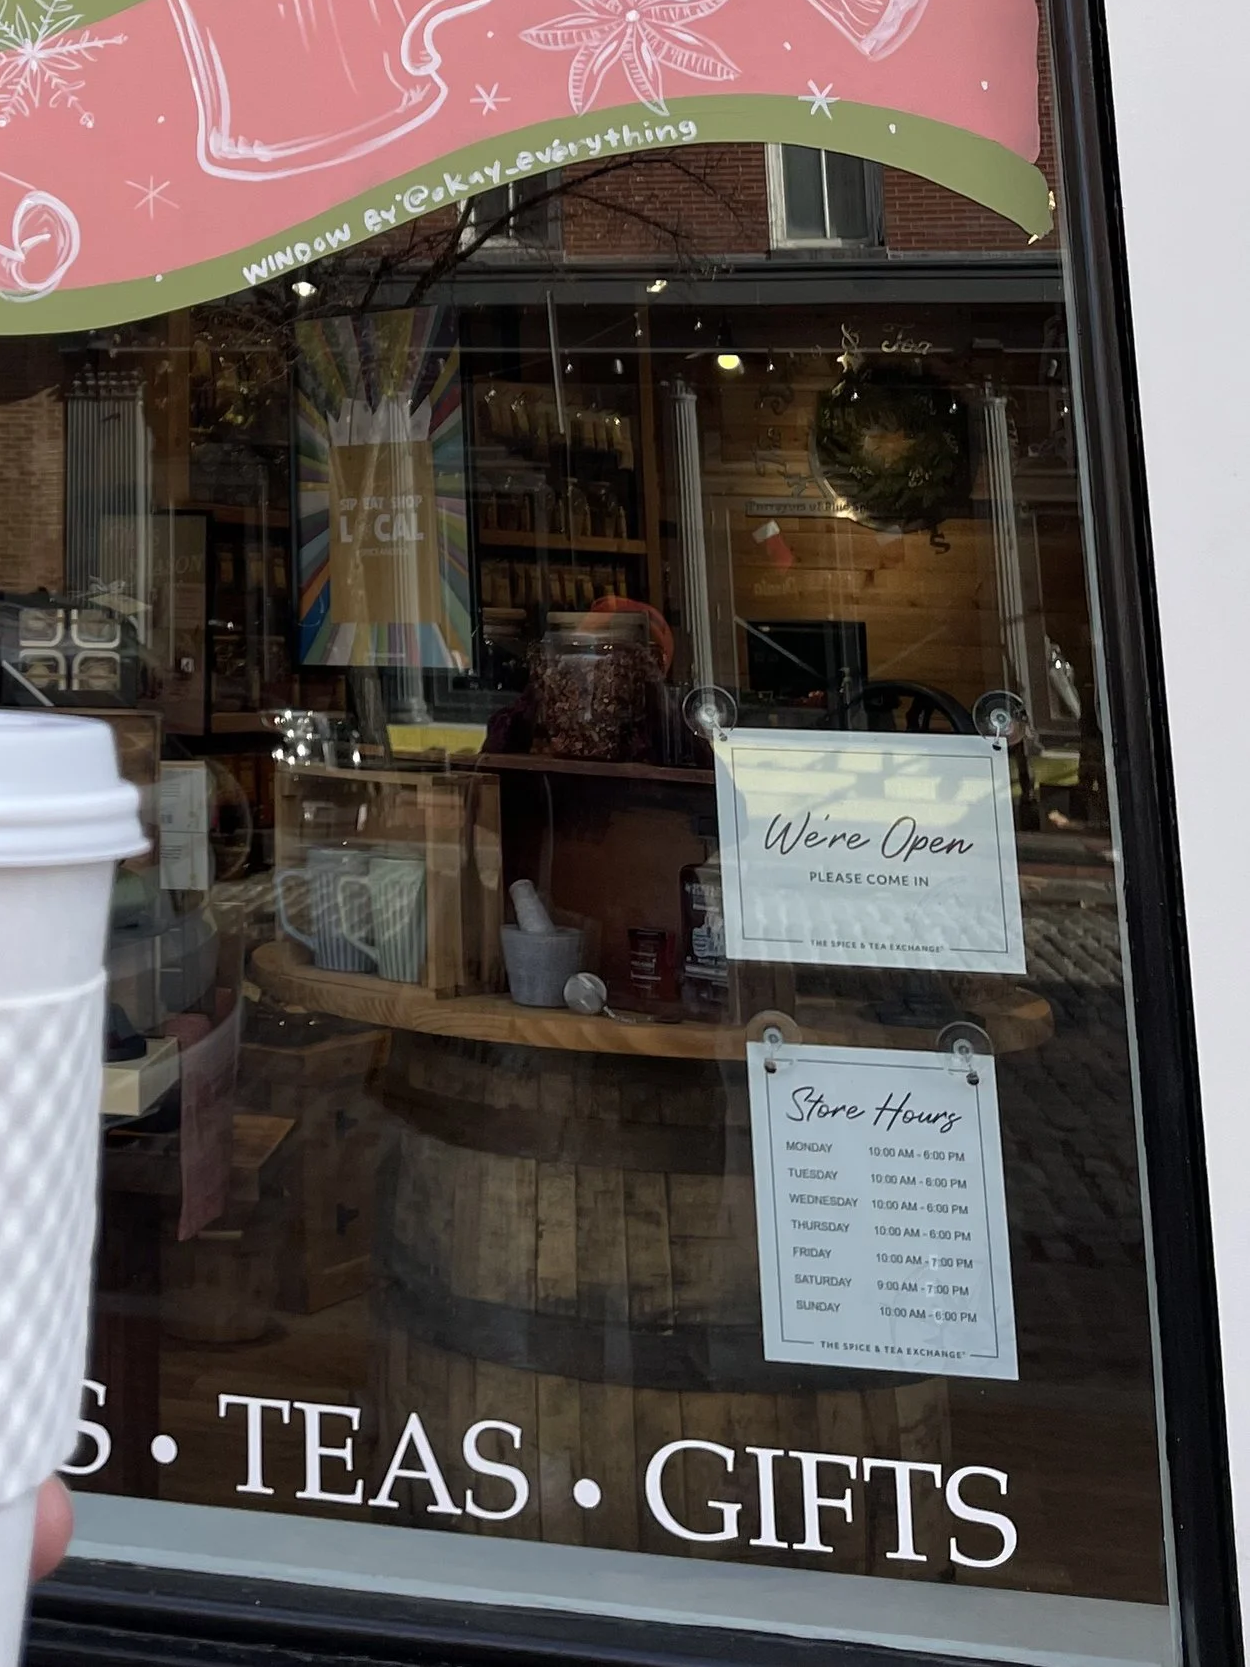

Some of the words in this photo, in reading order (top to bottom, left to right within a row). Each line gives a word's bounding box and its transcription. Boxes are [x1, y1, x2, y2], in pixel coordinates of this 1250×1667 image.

[242, 221, 352, 286] WINDOW
[363, 200, 398, 233] BY
[340, 498, 357, 511] SIP
[362, 496, 384, 510] EAT
[390, 494, 423, 509] SHOP
[339, 512, 425, 544] LCAL
[765, 811, 870, 856] We're
[881, 816, 974, 862] Open
[809, 871, 862, 885] PLEASE
[866, 873, 910, 886] COME
[914, 874, 929, 887] IN
[811, 939, 828, 948] THE
[830, 940, 857, 950] SPICE
[868, 942, 887, 951] TEA
[786, 1086, 865, 1122] Store
[872, 1092, 962, 1134] Hours
[786, 1141, 833, 1153] MONDAY
[868, 1146, 895, 1158] 10:00
[897, 1148, 915, 1158] AM
[948, 1151, 965, 1162] PM
[788, 1167, 838, 1180] TUESDAY
[870, 1173, 898, 1185] 10:00
[899, 1175, 917, 1186] AM
[950, 1179, 967, 1189] PM
[789, 1193, 859, 1207] WEDNESDAY
[872, 1199, 899, 1210] 10:00
[901, 1201, 918, 1212] AM
[951, 1204, 969, 1215] PM
[791, 1219, 850, 1232] THURSDAY
[874, 1225, 901, 1237] 10:00
[903, 1227, 920, 1238] AM
[954, 1231, 971, 1242] PM
[792, 1246, 832, 1259] FRIDAY
[876, 1253, 903, 1264] 10:00
[905, 1254, 922, 1265] AM
[931, 1257, 953, 1268] 7:00
[956, 1258, 974, 1269] PM
[794, 1273, 852, 1287] SATURDAY
[877, 1279, 899, 1291] 9:00
[901, 1281, 918, 1292] AM
[927, 1284, 949, 1295] 7:00
[952, 1285, 970, 1296] PM
[796, 1300, 841, 1312] SUNDAY
[879, 1306, 907, 1318] 10:00
[909, 1308, 926, 1319] AM
[960, 1311, 977, 1323] PM
[820, 1340, 840, 1350] THE
[843, 1342, 871, 1352] SPICE
[875, 1344, 881, 1353] &
[884, 1345, 903, 1355] TEA
[217, 1393, 530, 1521] TEAS
[644, 1439, 1020, 1569] GIFTS
